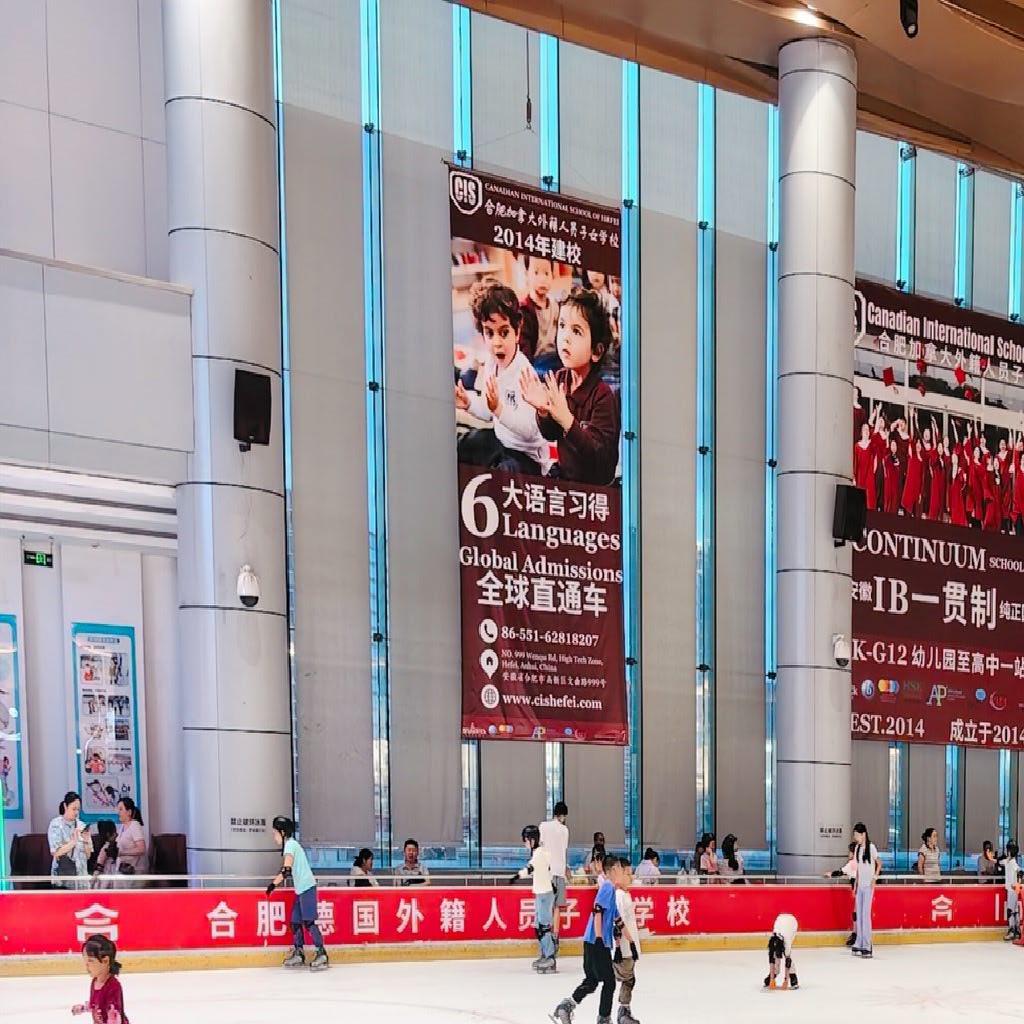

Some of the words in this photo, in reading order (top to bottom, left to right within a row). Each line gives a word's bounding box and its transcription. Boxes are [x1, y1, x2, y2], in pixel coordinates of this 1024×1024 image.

[484, 182, 520, 200] CANADIAN
[520, 193, 569, 212] INTERNATIONAL
[569, 206, 591, 219] SCHOOL
[493, 225, 582, 265] 2014年建校
[867, 301, 921, 337] Canadian
[923, 316, 995, 356] International
[461, 473, 500, 539] 6
[502, 478, 610, 522] 大语言习得
[502, 512, 621, 554] Languages
[459, 546, 518, 571] Global
[522, 554, 623, 583] Admissions
[989, 557, 1024, 573] SCHOOL
[476, 569, 608, 618] 全球直通车
[872, 575, 997, 631] IB一贯制
[501, 626, 600, 647] 86-551-62818207
[851, 638, 908, 667] K-G12
[502, 693, 603, 711] www.cishefei.com
[851, 713, 926, 738] EST.2014
[206, 895, 691, 939] 合肥德国外籍人员子学校
